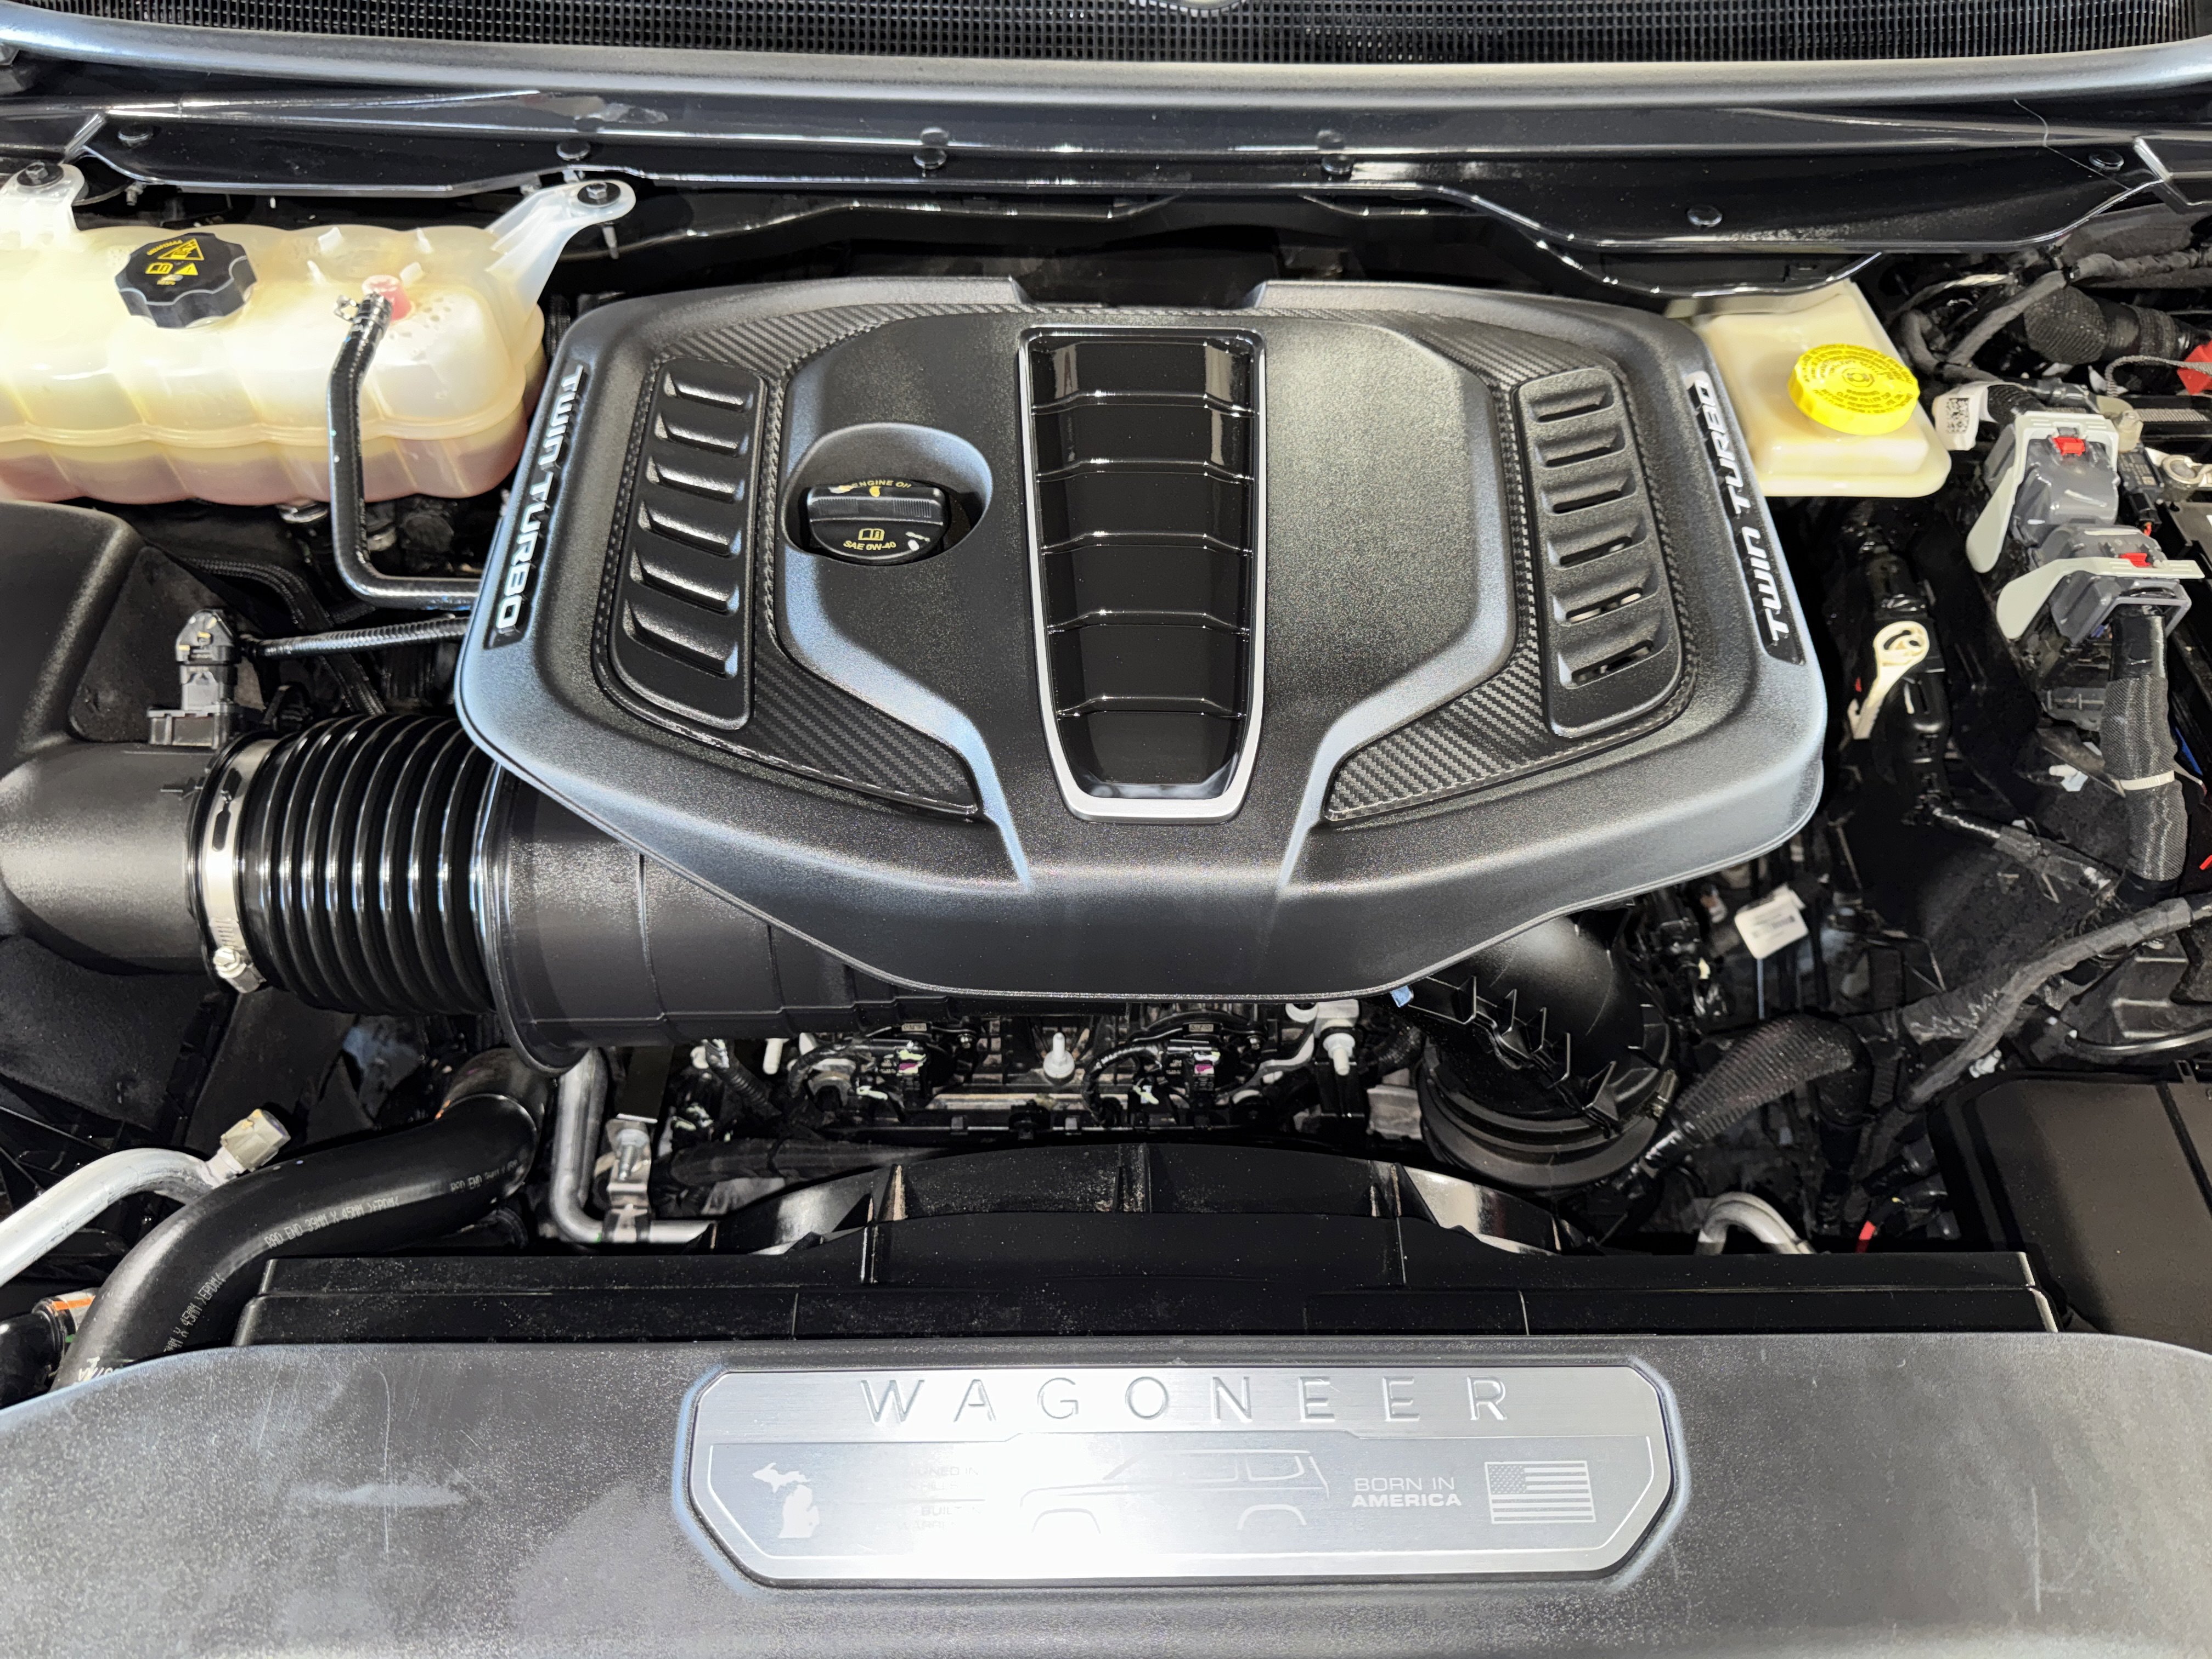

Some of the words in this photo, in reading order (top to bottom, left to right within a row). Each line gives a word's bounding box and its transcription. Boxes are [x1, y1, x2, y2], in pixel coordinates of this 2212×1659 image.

[539, 364, 583, 465] TWIN
[1695, 380, 1751, 515] TURBO
[851, 479, 894, 488] ENGINE
[496, 471, 554, 628] TURBO
[843, 540, 865, 550] SAE
[866, 541, 896, 550] 0W-40
[1741, 526, 1790, 641] TWIN
[264, 1232, 284, 1249] RAD
[284, 1223, 303, 1240] END
[304, 1213, 329, 1232] 39MM
[330, 1210, 339, 1223] X
[341, 1204, 365, 1220] 45MM
[860, 1375, 1508, 1424] WAGONEER
[1351, 1493, 1462, 1508] AMERICA
[1354, 1477, 1423, 1491] BORN
[1432, 1476, 1455, 1490] IN
